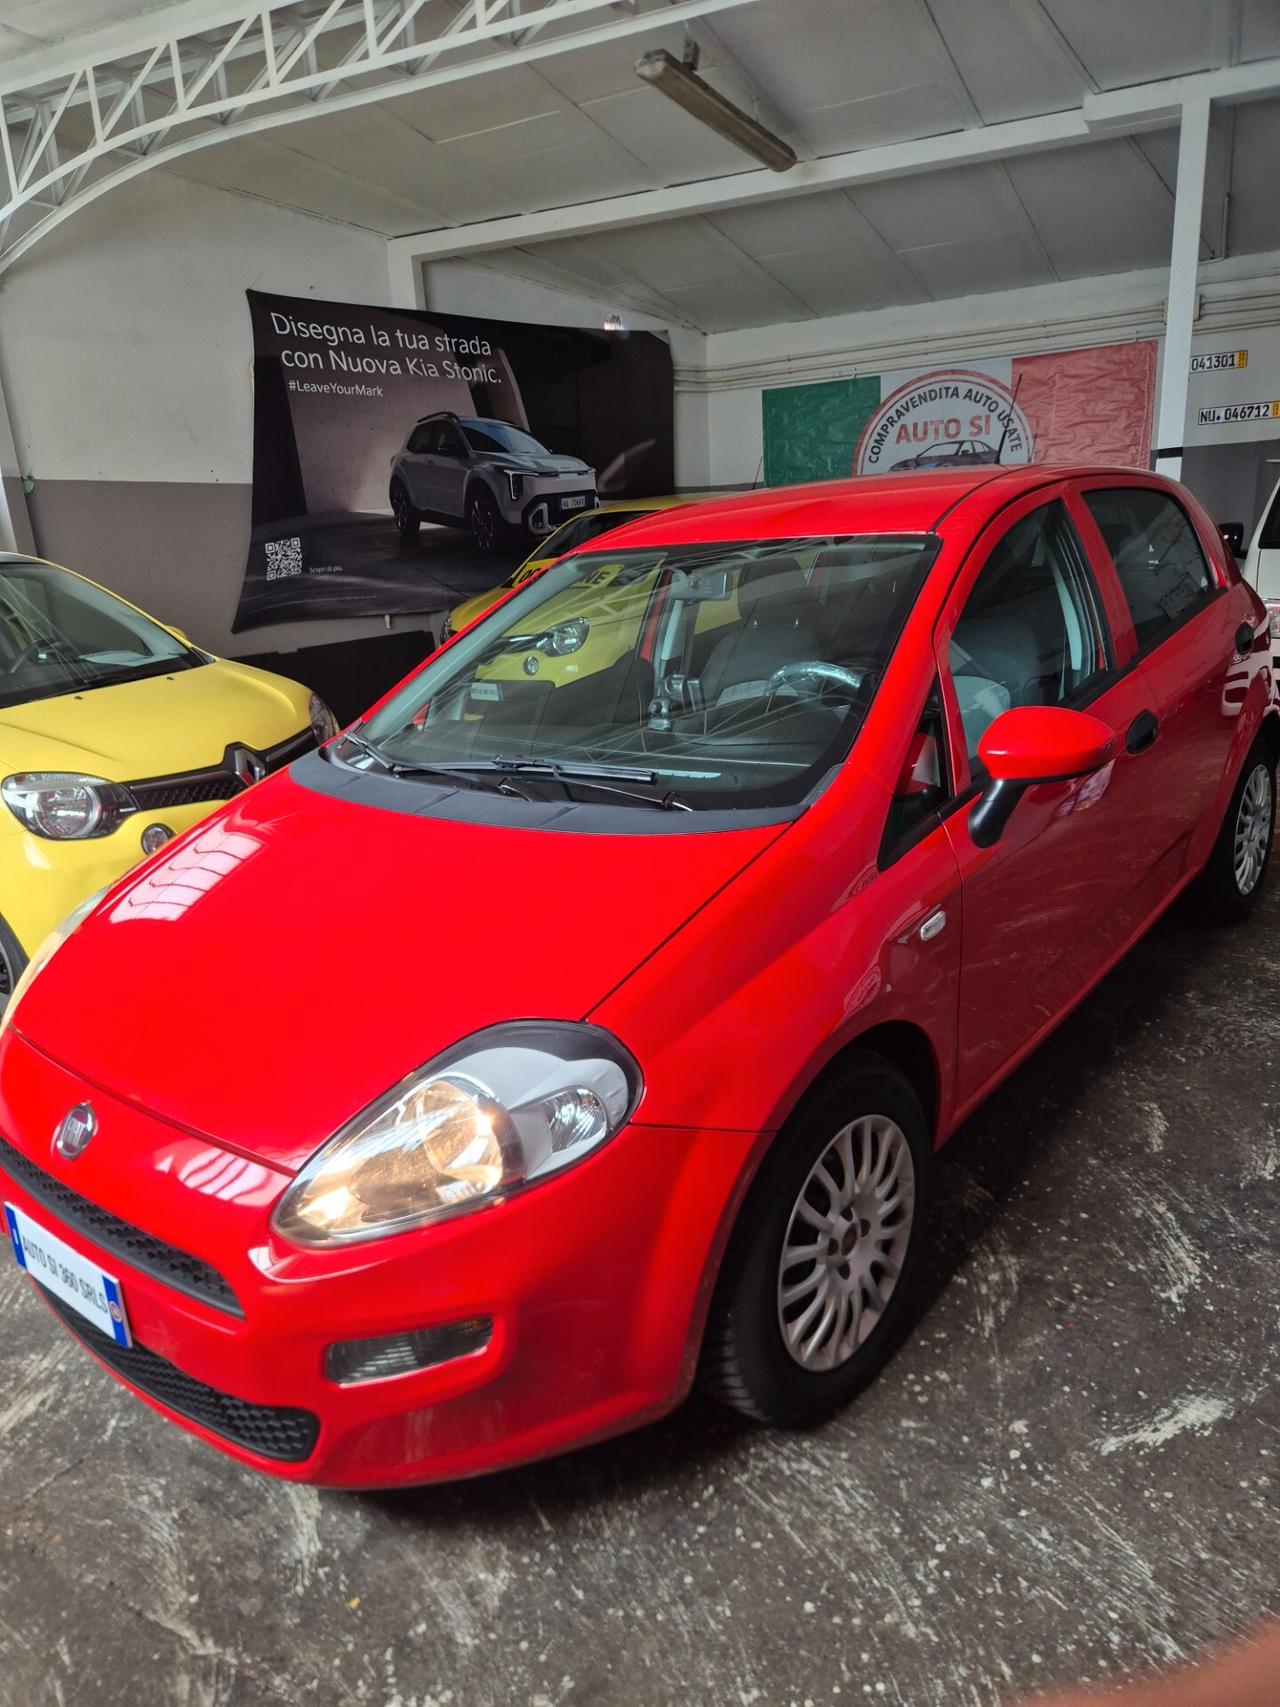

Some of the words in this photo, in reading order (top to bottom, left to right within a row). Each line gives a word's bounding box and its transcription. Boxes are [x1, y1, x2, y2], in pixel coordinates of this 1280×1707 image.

[270, 312, 366, 346] Disegna
[370, 325, 391, 347] la
[395, 329, 430, 350] tua
[434, 333, 492, 356] strada
[281, 349, 324, 371] con
[329, 349, 401, 376] Nuova
[406, 356, 439, 378] Kia
[442, 359, 502, 384] Stonic.
[1191, 353, 1236, 371] 041301
[288, 379, 384, 398] #LeaveYourMark
[868, 386, 960, 464] COMPRAVENDITA
[963, 388, 999, 413] AUTO
[997, 409, 1023, 452] USATE
[1224, 404, 1270, 421] 046712
[895, 418, 961, 445] AUTO
[969, 414, 991, 438] SI
[22, 1235, 47, 1269] AUTO
[47, 1254, 59, 1279] SI
[59, 1263, 78, 1293] 360
[79, 1277, 108, 1314] SRLS
